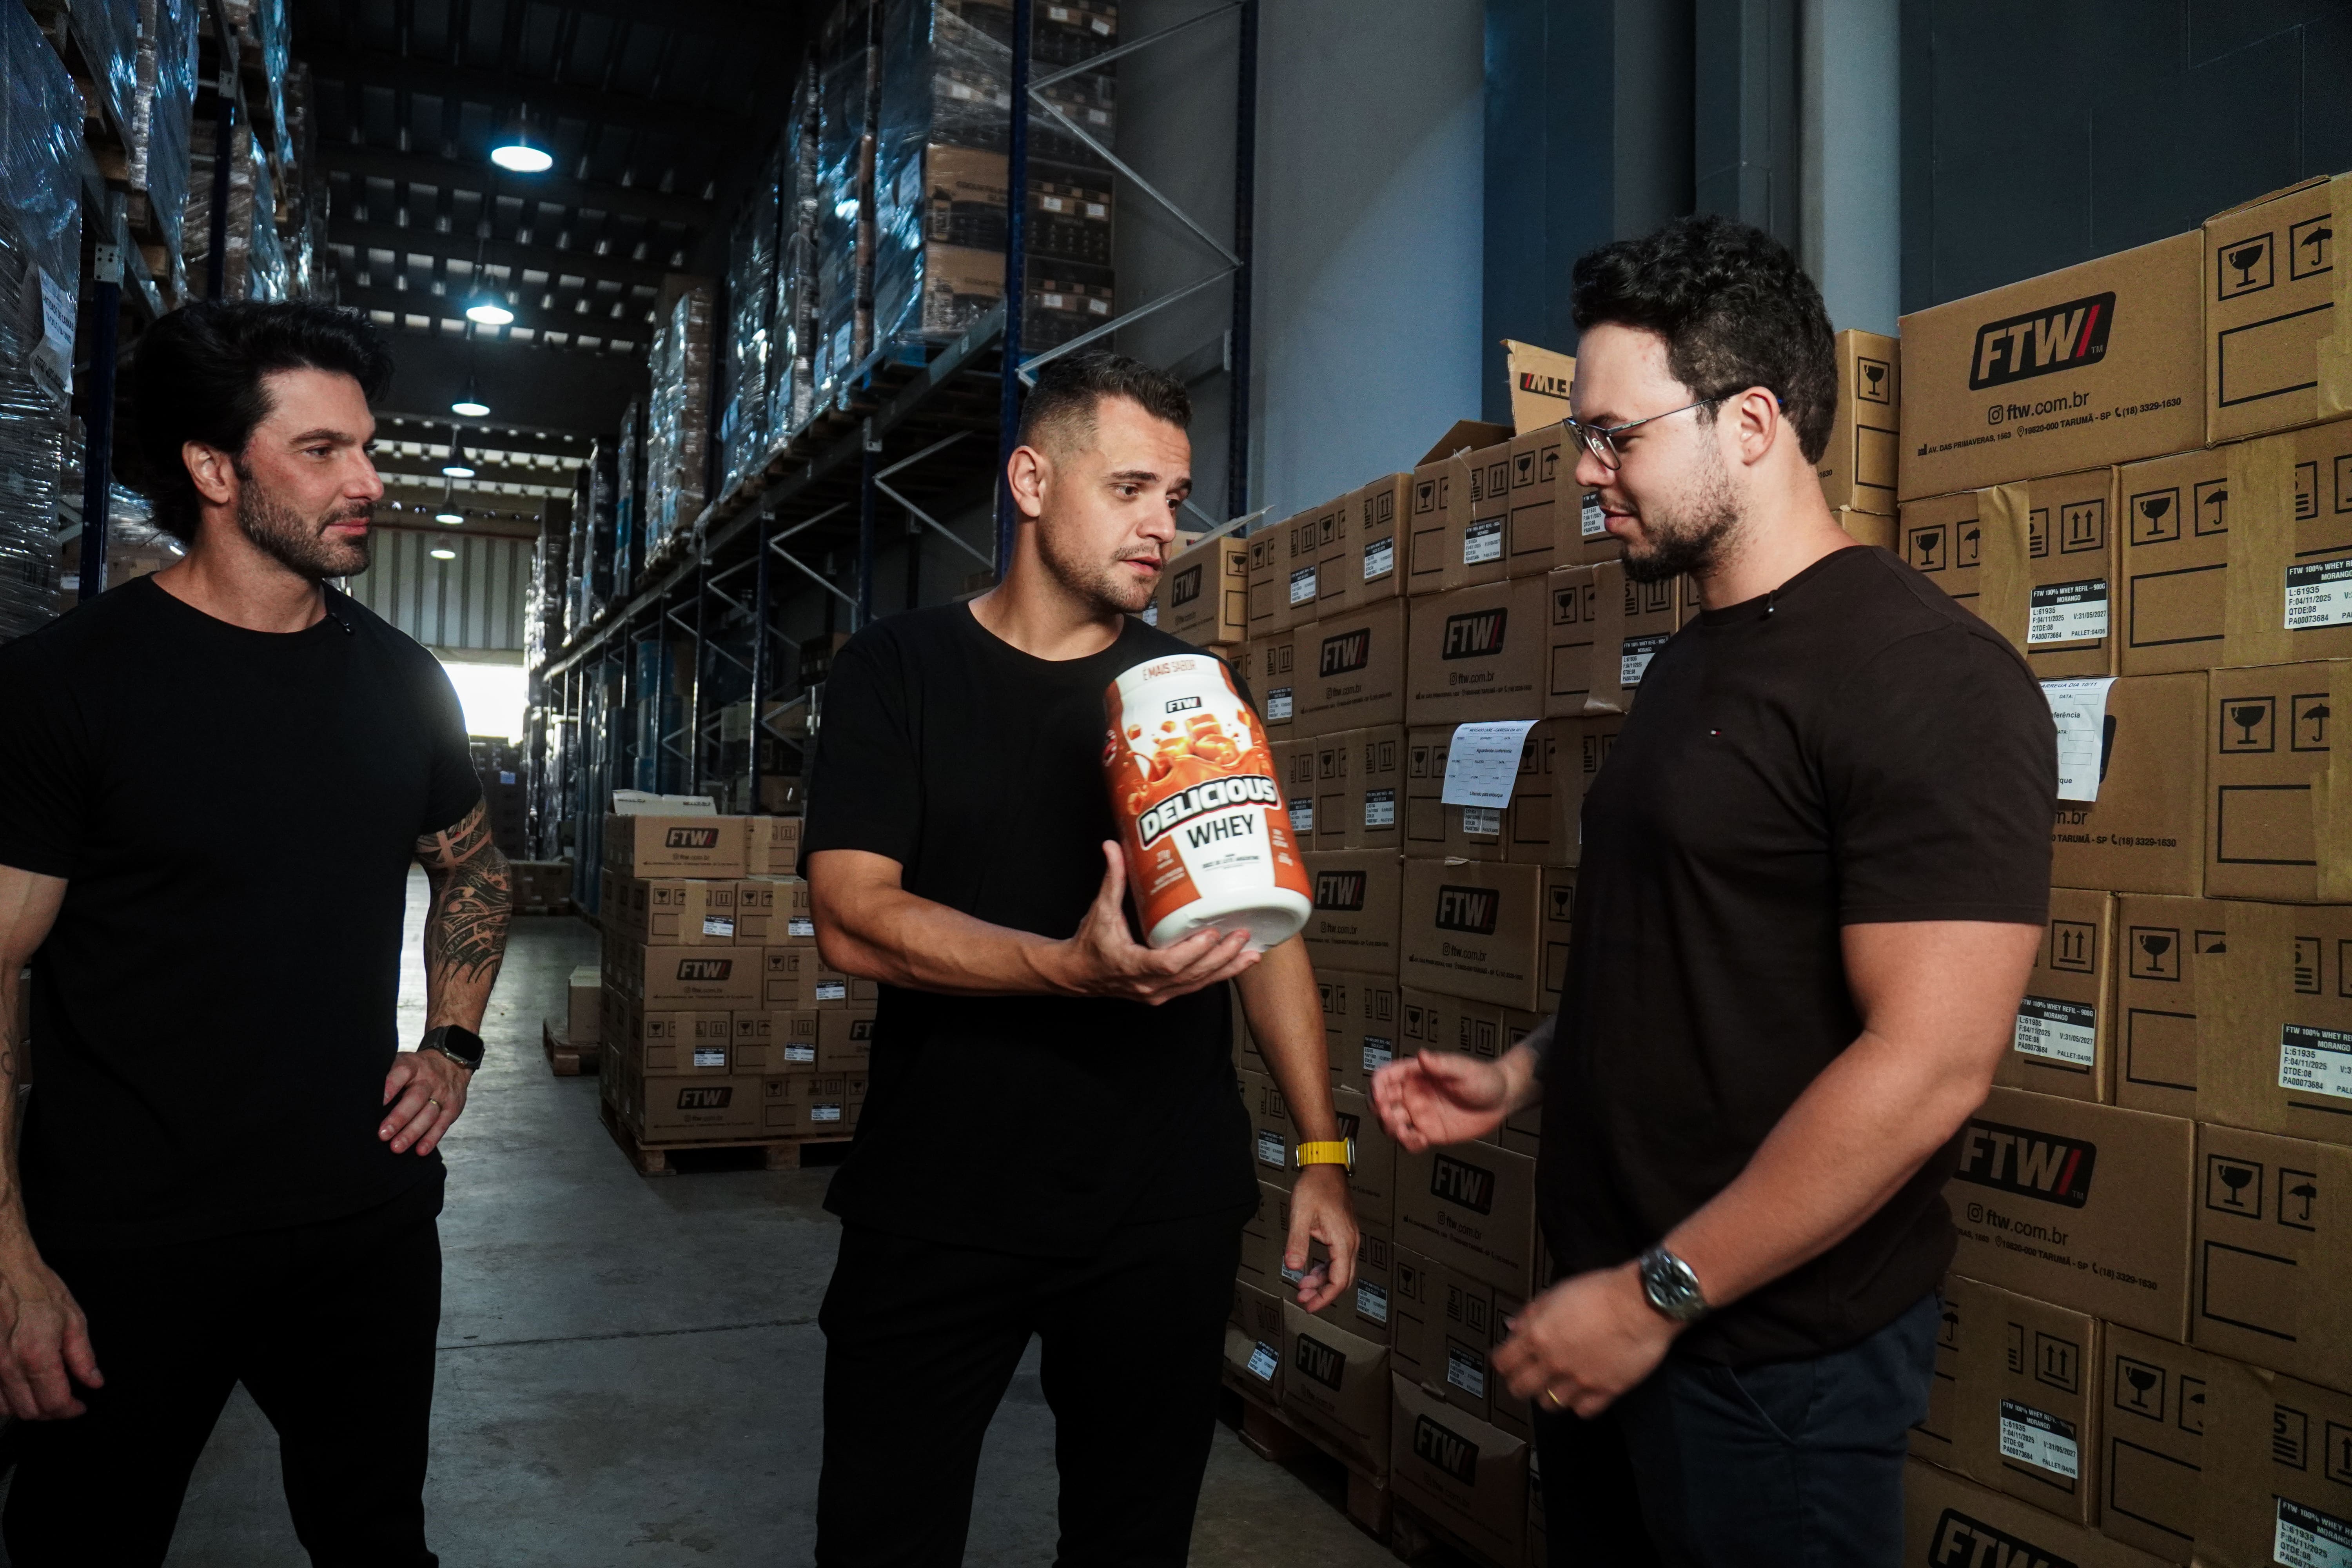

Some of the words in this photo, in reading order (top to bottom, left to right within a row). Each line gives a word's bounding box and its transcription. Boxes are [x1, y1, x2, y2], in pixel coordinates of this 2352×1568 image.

[1978, 307, 2085, 381] FTW
[2007, 392, 2090, 421] ftw.com.br
[1929, 446, 1938, 454] AV.
[1940, 443, 1952, 452] DAS
[1954, 434, 1995, 449] PRIMAVERAS,
[1997, 432, 2011, 440] 1563
[2025, 422, 2058, 436] 19820-000
[2061, 414, 2094, 428] TARUMÃ
[2100, 412, 2111, 420] SP
[2123, 406, 2137, 417] (18)
[2140, 397, 2181, 412] 3329-1630
[2325, 561, 2343, 570] WHEY
[2289, 586, 2319, 596] L:61935
[2057, 595, 2081, 603] MORANGO
[2289, 594, 2331, 605] F:04/11/2025
[2074, 610, 2106, 619] V:31/05/2027
[2289, 606, 2316, 615] QTDE:08
[2289, 614, 2328, 624] PA00073684
[1448, 615, 1495, 654] FTW
[1322, 635, 1360, 672] FTW
[1148, 663, 1170, 677] MAIS
[1458, 671, 1494, 684] ftw.com.br
[1167, 697, 1196, 713] FTW
[1140, 777, 1276, 840] DELICIOUS
[668, 830, 709, 846] FTW
[1187, 813, 1254, 849] WHEY
[2058, 834, 2090, 843] TARUMÃ
[2119, 837, 2133, 846] (18)
[2136, 838, 2176, 847] 3329-1630
[1317, 876, 1356, 906] FTW
[1439, 890, 1488, 927] FTW
[1451, 945, 1487, 961] ftw.com.br
[680, 962, 722, 978] FTW
[2020, 1017, 2042, 1026] L:61935
[2044, 1011, 2068, 1021] MORANGO
[854, 1023, 873, 1038] FT
[2019, 1025, 2050, 1036] F:04/11/2025
[2302, 1028, 2320, 1037] 100%
[2322, 1031, 2341, 1040] WHEY
[2019, 1033, 2039, 1043] QTDE:08
[2060, 1033, 2092, 1044] V:31/05/2027
[2018, 1042, 2047, 1053] PA00073684
[2285, 1047, 2316, 1058] L:61935
[2318, 1040, 2350, 1051] MORANGO
[2284, 1057, 2327, 1070] F:04/11/2025
[2284, 1067, 2311, 1077] QTDE:08
[2283, 1076, 2323, 1089] PA00073684
[681, 1090, 722, 1107] FTW
[1959, 1125, 2067, 1192] FTW
[1434, 1159, 1483, 1205] FTW
[1446, 1216, 1482, 1240] ftw.com.br
[1986, 1210, 2069, 1245] ftw.com.br
[2039, 1250, 2071, 1266] TARUMÃ
[2078, 1261, 2088, 1270] SP
[2100, 1267, 2114, 1280] (18)
[2117, 1272, 2157, 1290] 3329-1630
[1298, 1338, 1334, 1381] FTW
[2029, 1408, 2042, 1418] WHEY
[2003, 1420, 2025, 1432] L:61935
[2026, 1417, 2050, 1430] MORANGO
[2003, 1428, 2034, 1443] F:04/11/2025
[2004, 1437, 2024, 1448] QTDE:08
[1418, 1420, 1466, 1473] FTW
[2003, 1445, 2033, 1460] PA00073684
[2043, 1441, 2076, 1457] V:31/05/2027
[2042, 1459, 2076, 1474] PALLET:04/06
